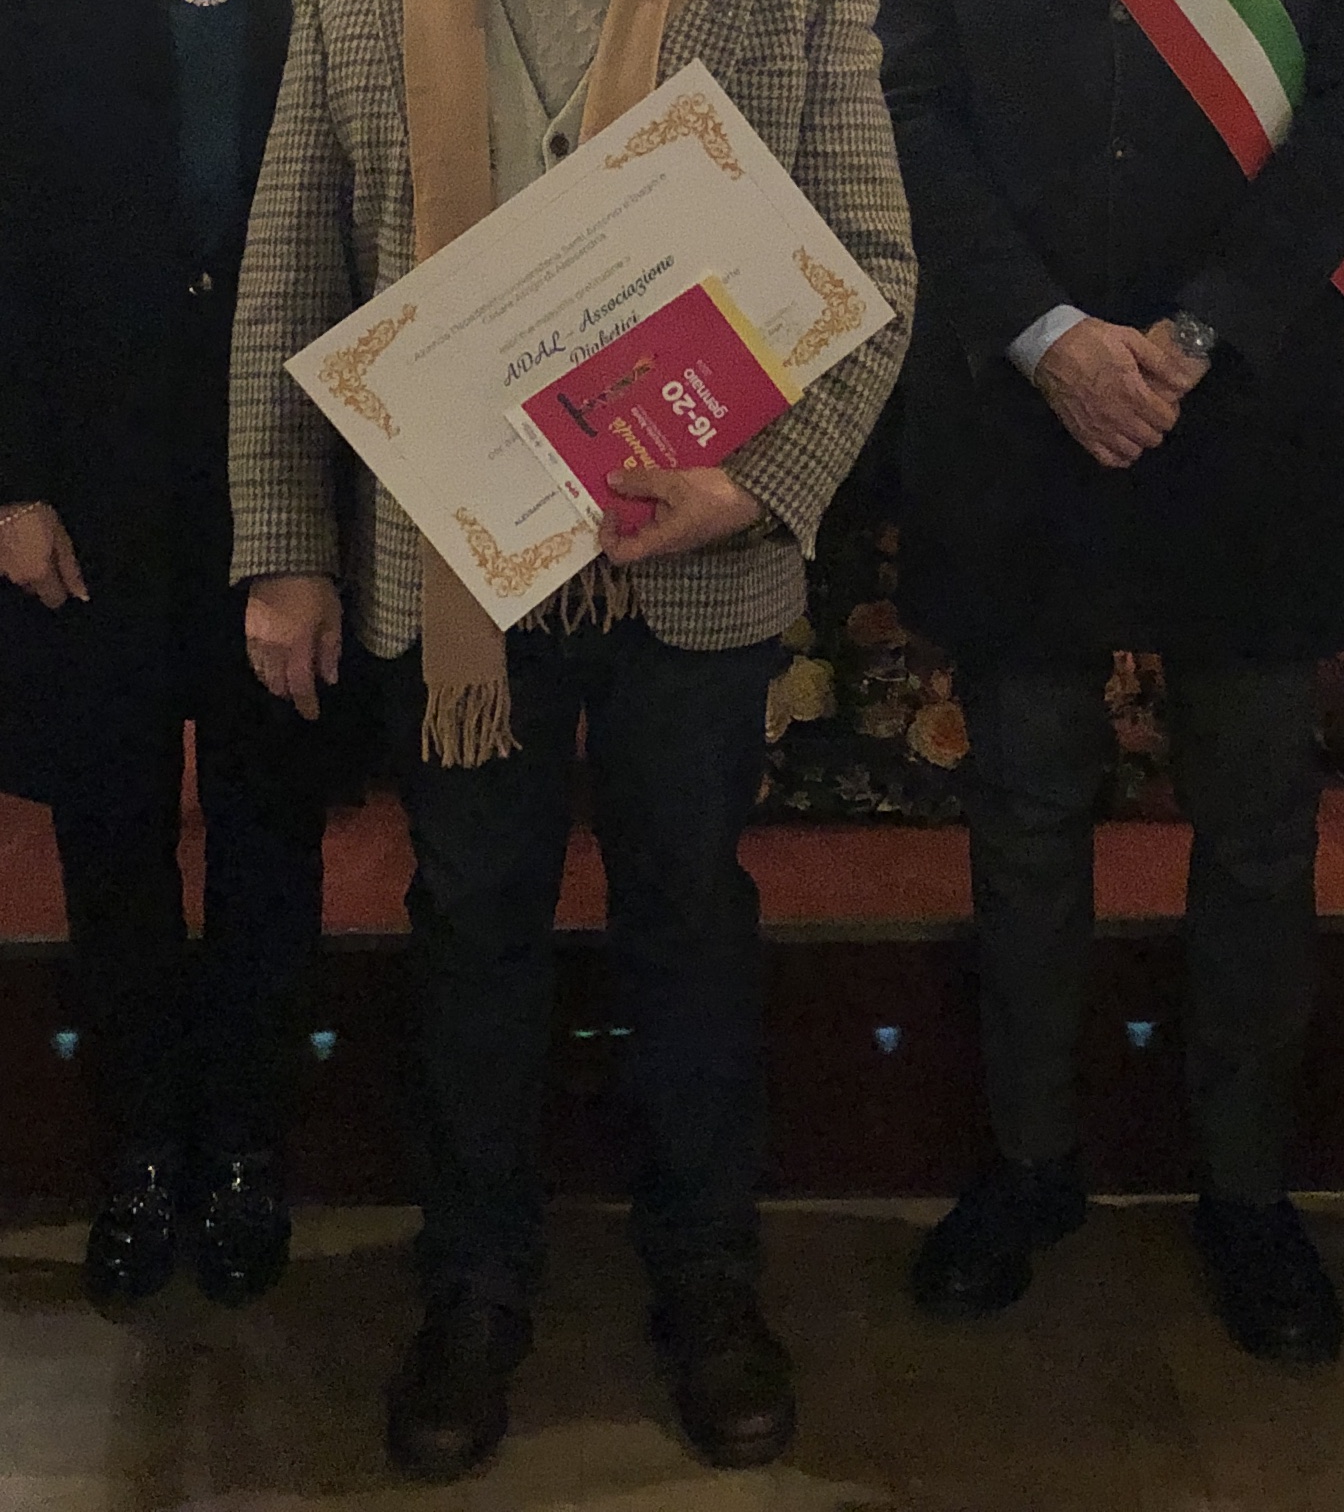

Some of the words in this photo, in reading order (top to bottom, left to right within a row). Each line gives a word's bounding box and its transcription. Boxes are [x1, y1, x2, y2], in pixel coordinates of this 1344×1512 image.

[504, 329, 566, 387] ADAL
[579, 255, 677, 333] Associazione
[569, 308, 639, 365] Diabetici
[661, 380, 717, 447] 16-20
[683, 367, 728, 418] gennaio
